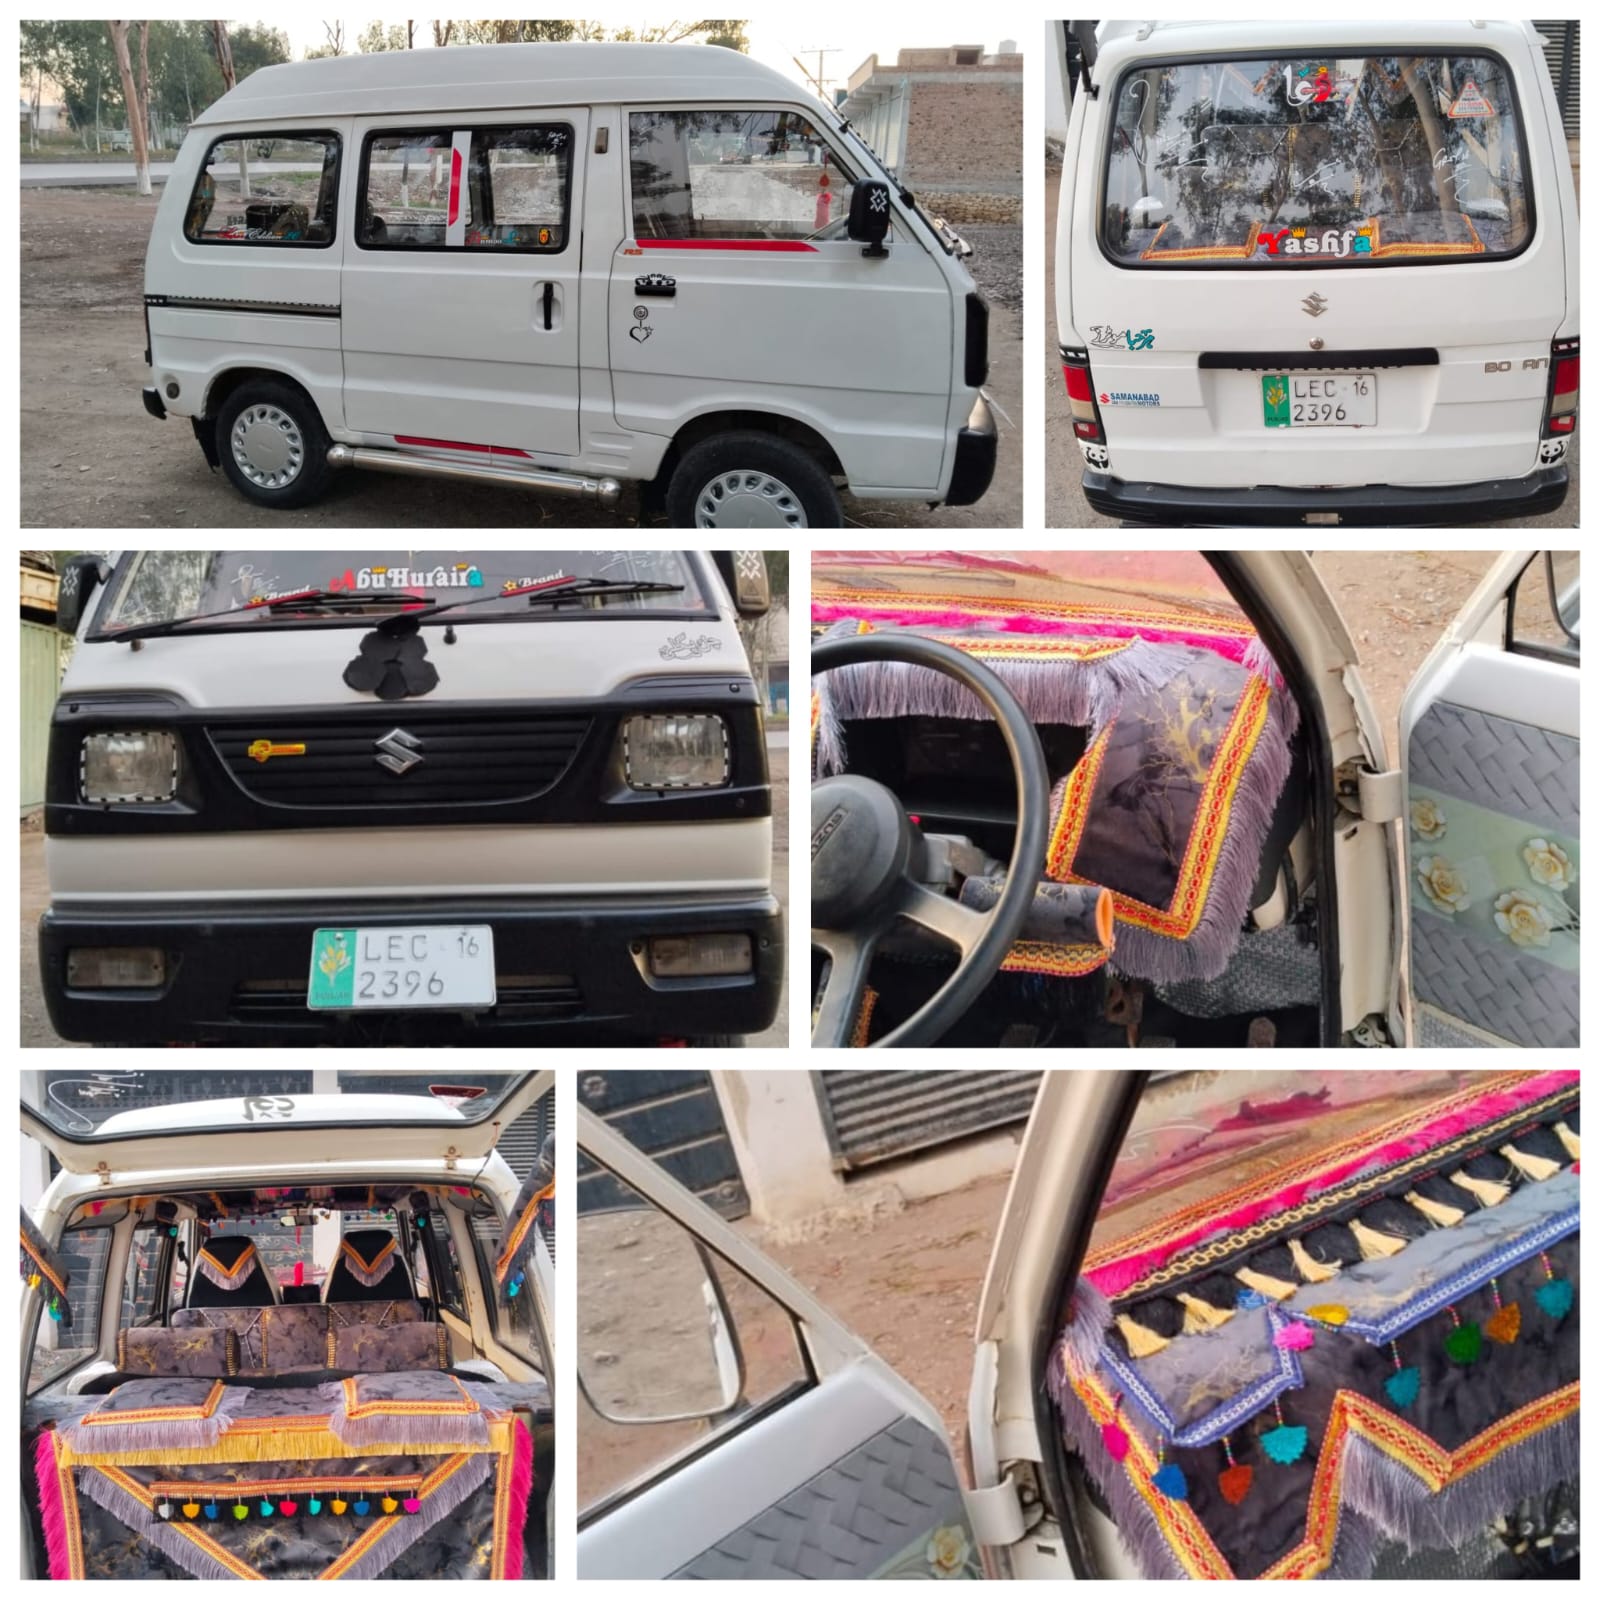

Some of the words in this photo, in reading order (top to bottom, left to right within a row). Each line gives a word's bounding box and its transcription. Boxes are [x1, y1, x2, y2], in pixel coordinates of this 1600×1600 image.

[1257, 230, 1372, 257] Yashfa
[1110, 392, 1160, 402] SAMANABAD
[1294, 380, 1335, 398] LEC
[1353, 381, 1368, 396] 16
[1294, 403, 1346, 421] 2396
[518, 569, 564, 588] Brand
[364, 934, 429, 962] LEC
[457, 935, 481, 957] 16
[359, 970, 445, 999] 2396
